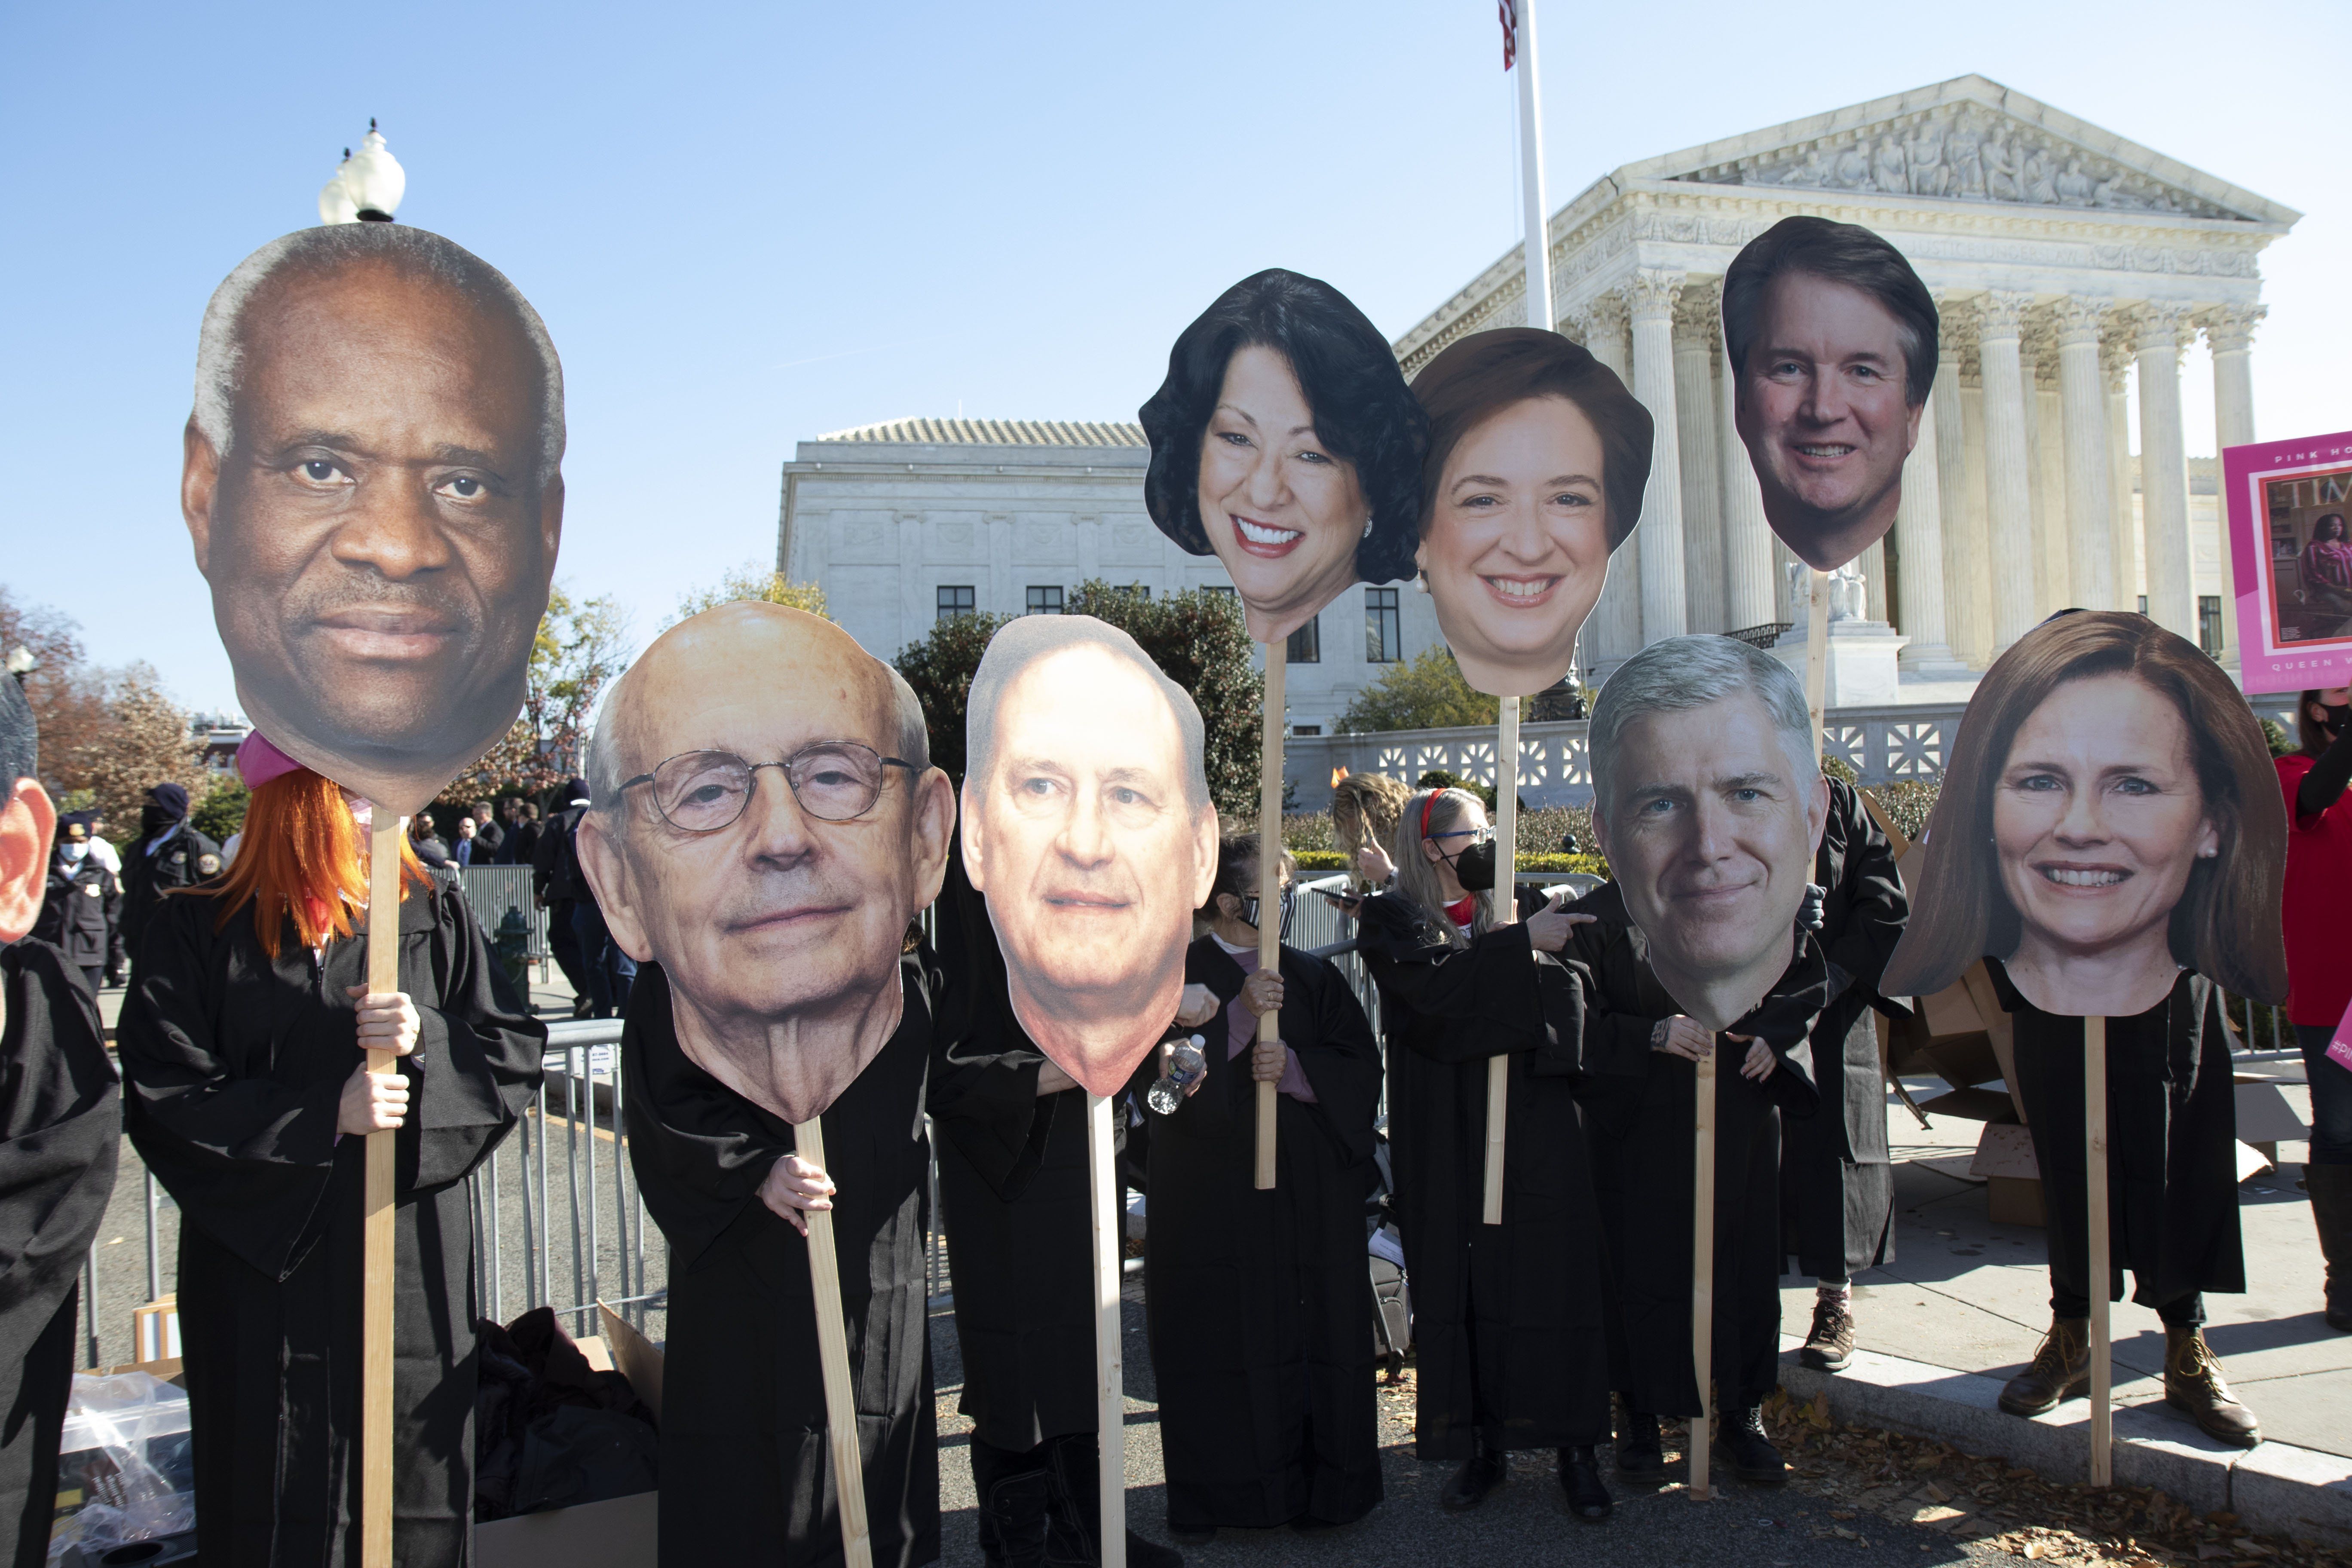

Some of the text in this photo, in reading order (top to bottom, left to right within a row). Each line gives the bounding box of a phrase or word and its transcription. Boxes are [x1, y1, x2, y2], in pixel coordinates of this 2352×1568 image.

[1908, 239, 1975, 257] JUSTICE
[1983, 243, 2039, 261] UNDER
[2275, 451, 2318, 463] PINK
[2272, 659, 2332, 671] QUEEN
